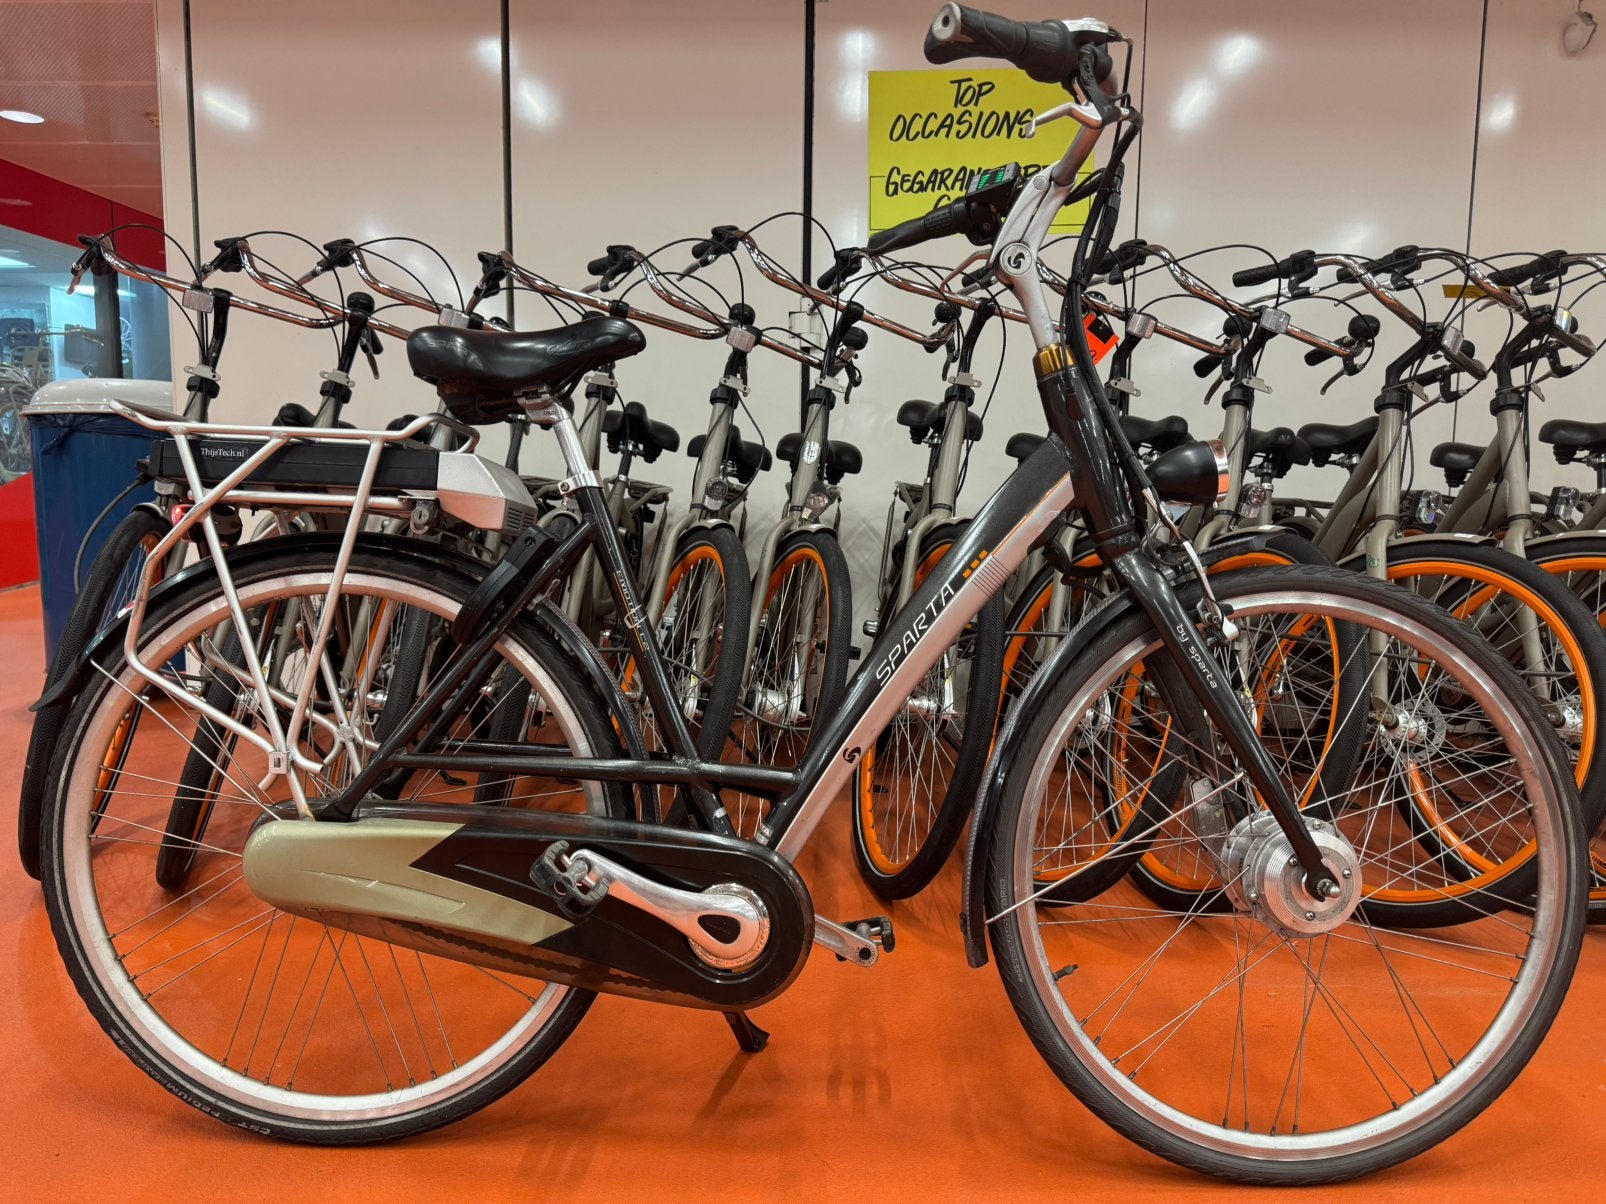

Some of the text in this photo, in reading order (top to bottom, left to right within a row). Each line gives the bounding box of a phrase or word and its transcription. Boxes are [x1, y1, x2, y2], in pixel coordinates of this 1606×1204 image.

[950, 78, 995, 108] TOP
[889, 108, 1034, 142] OCCASIONS
[201, 447, 245, 458] ThijsTech.nl
[876, 581, 955, 687] SPARTA
[1176, 624, 1218, 689] by sparta
